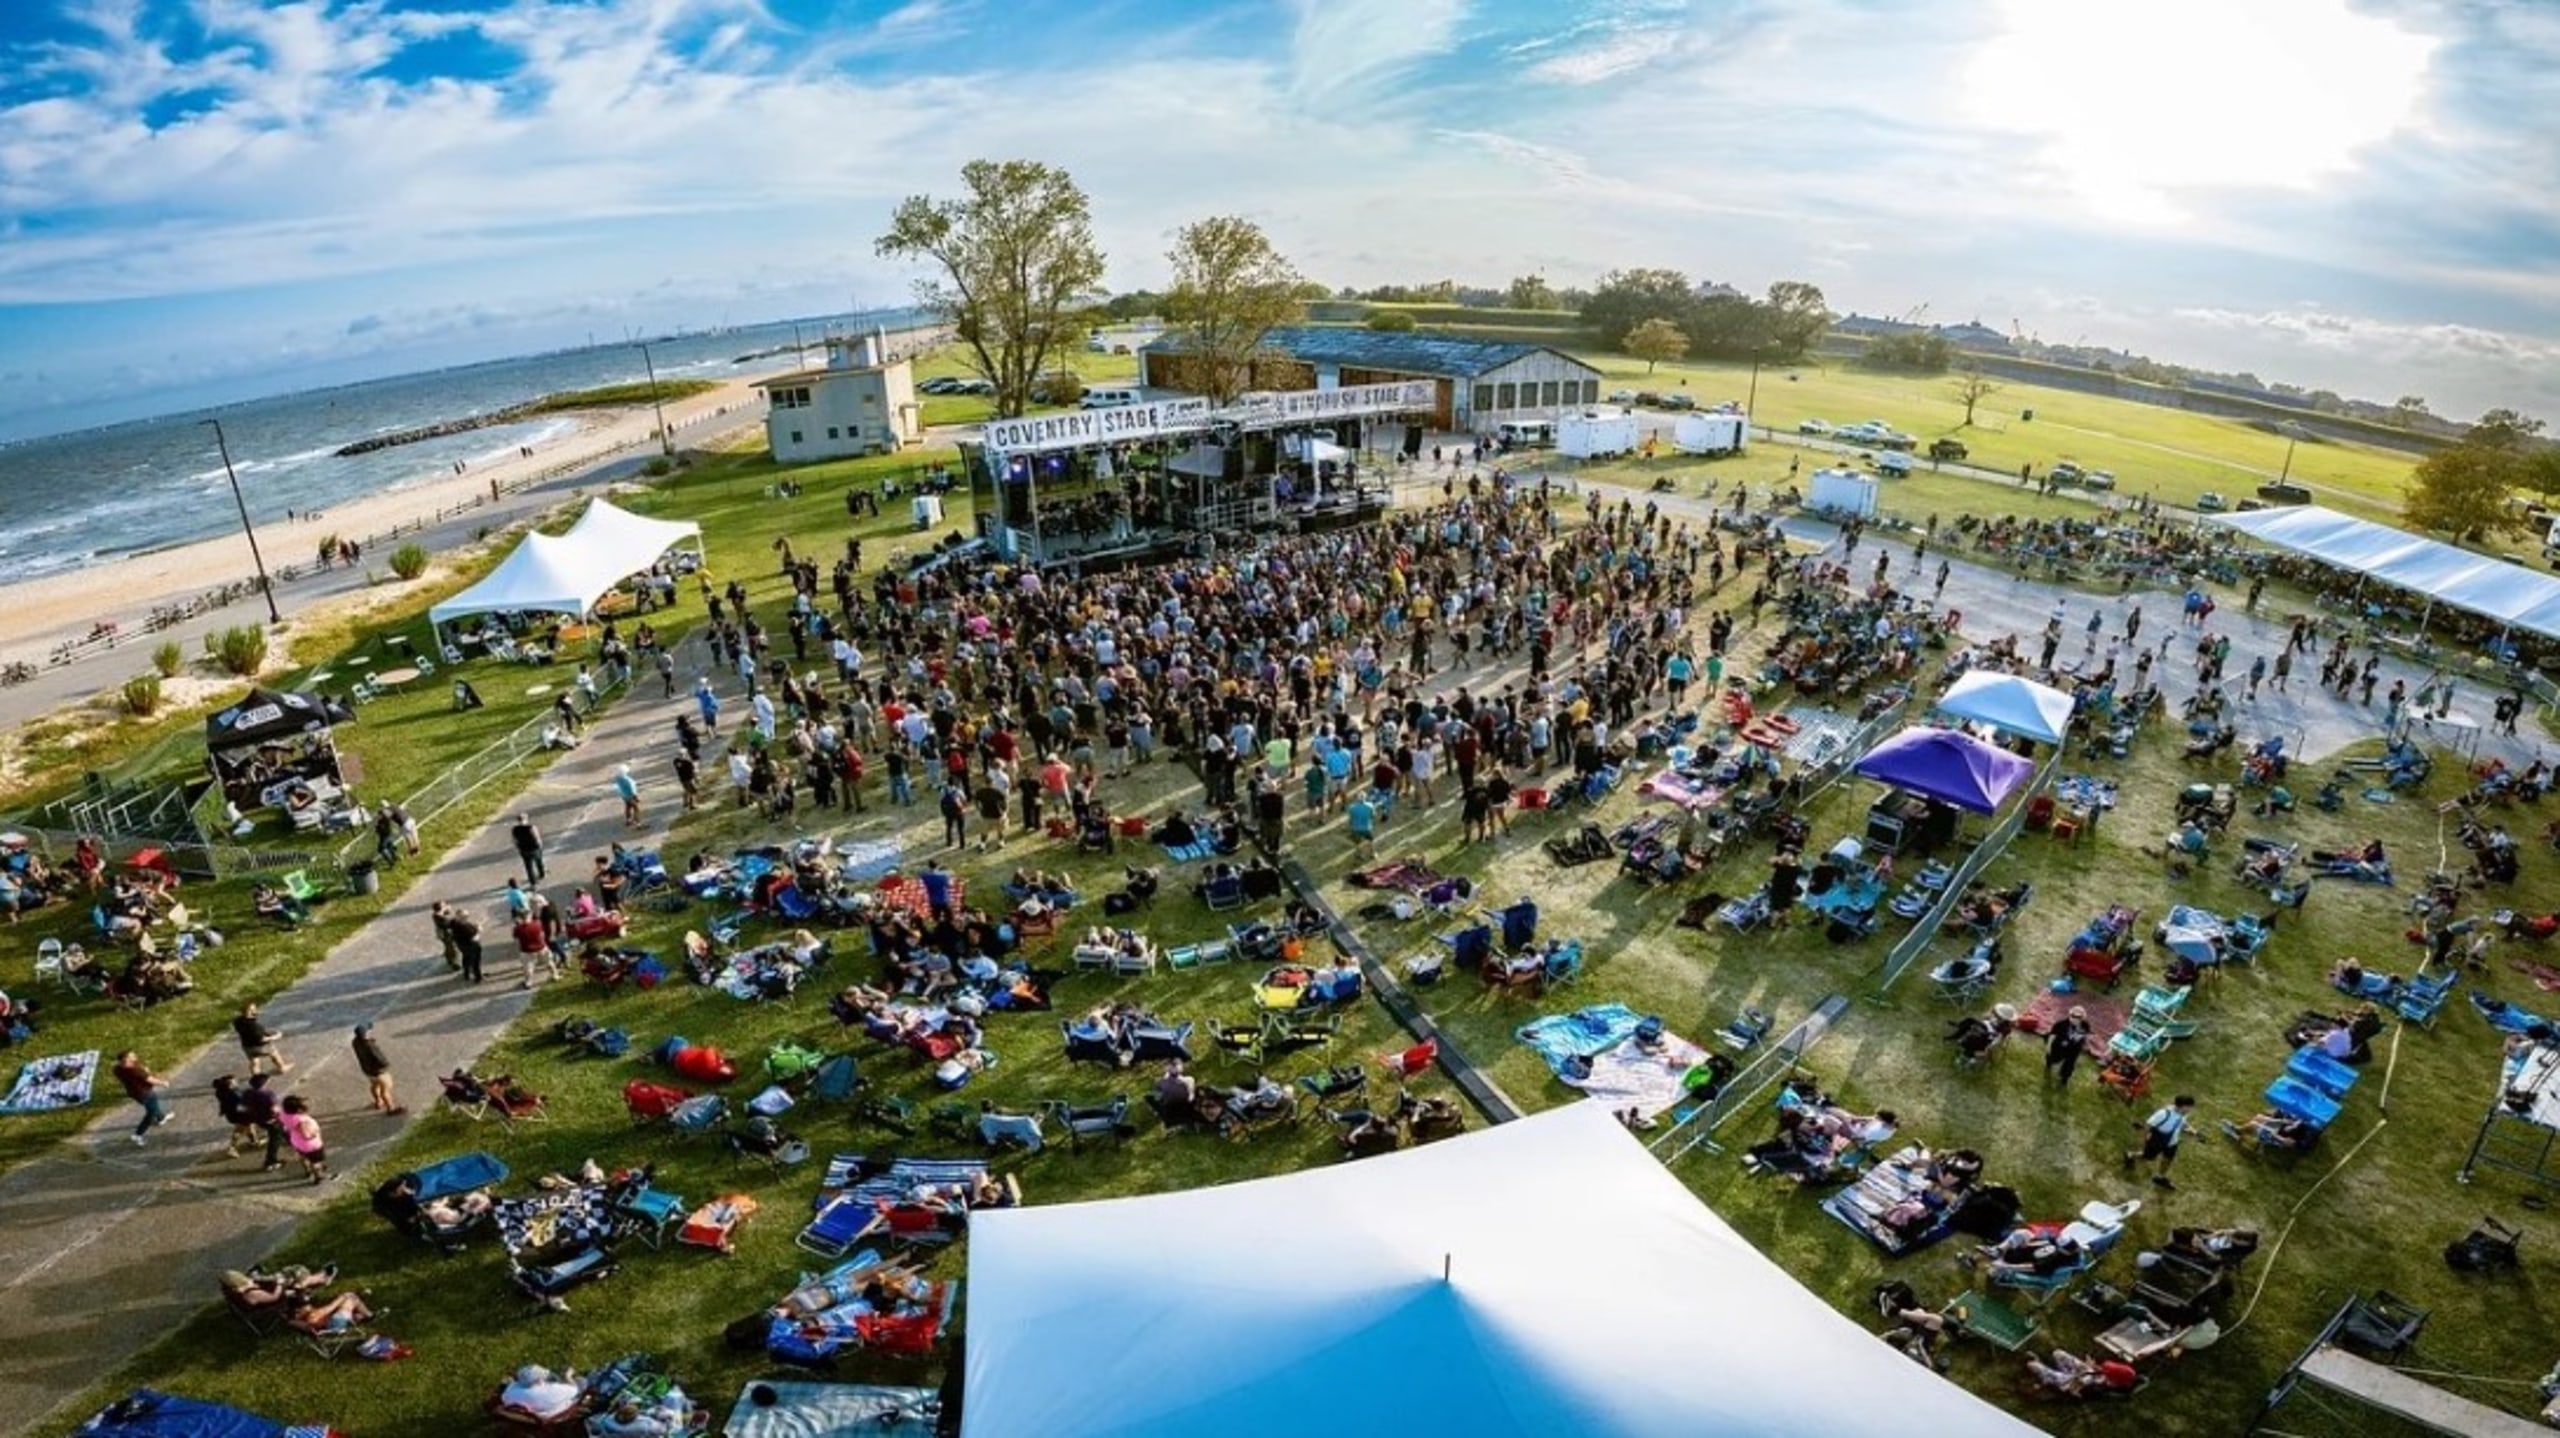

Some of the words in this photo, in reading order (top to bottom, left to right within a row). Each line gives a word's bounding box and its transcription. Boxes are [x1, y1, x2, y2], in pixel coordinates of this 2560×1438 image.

[1364, 387, 1400, 405] STAGE
[996, 414, 1093, 446] COVENTRY
[1106, 407, 1158, 432] STAGE
